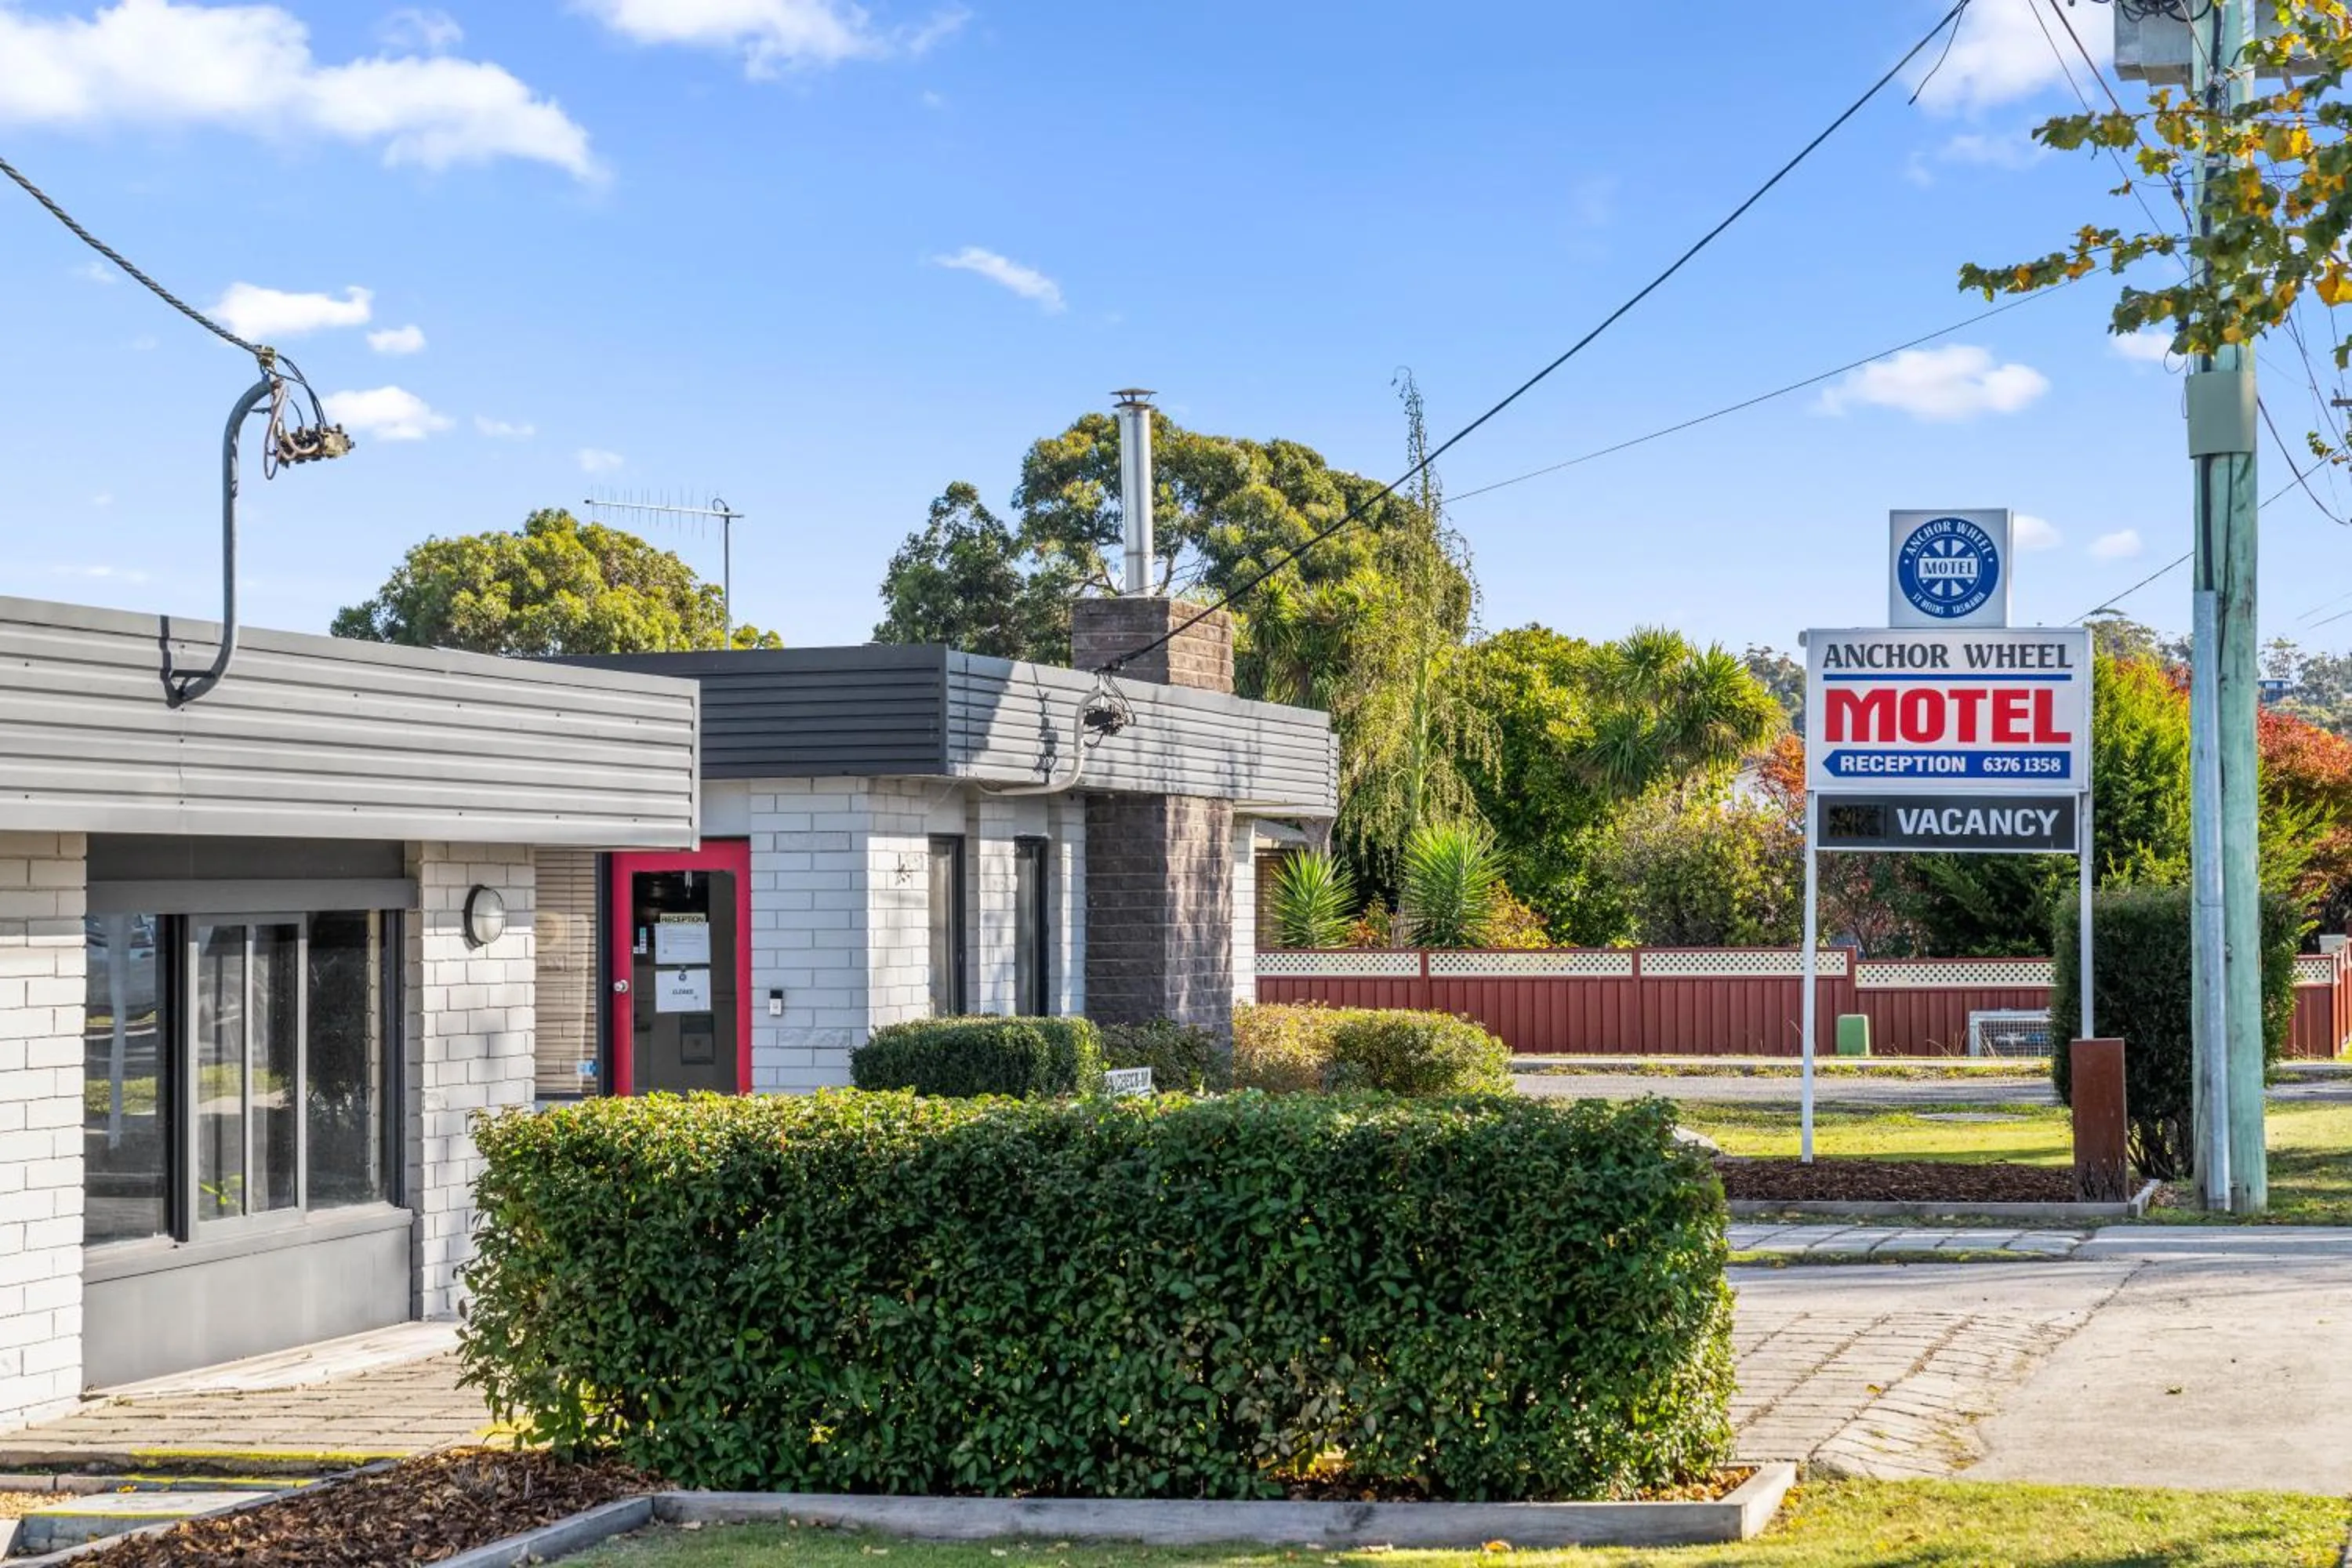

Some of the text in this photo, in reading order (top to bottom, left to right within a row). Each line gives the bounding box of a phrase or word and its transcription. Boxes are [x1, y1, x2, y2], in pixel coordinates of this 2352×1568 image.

[1906, 521, 1992, 557] ANCHOR WHEEL
[1923, 561, 1975, 575] MOTEL
[1823, 644, 2073, 668] ANCHOR WHEEL
[1825, 688, 2071, 743] MOTEL
[1840, 755, 2061, 773] RECEPTION 6376 1358
[1896, 808, 2060, 836] VACANCY
